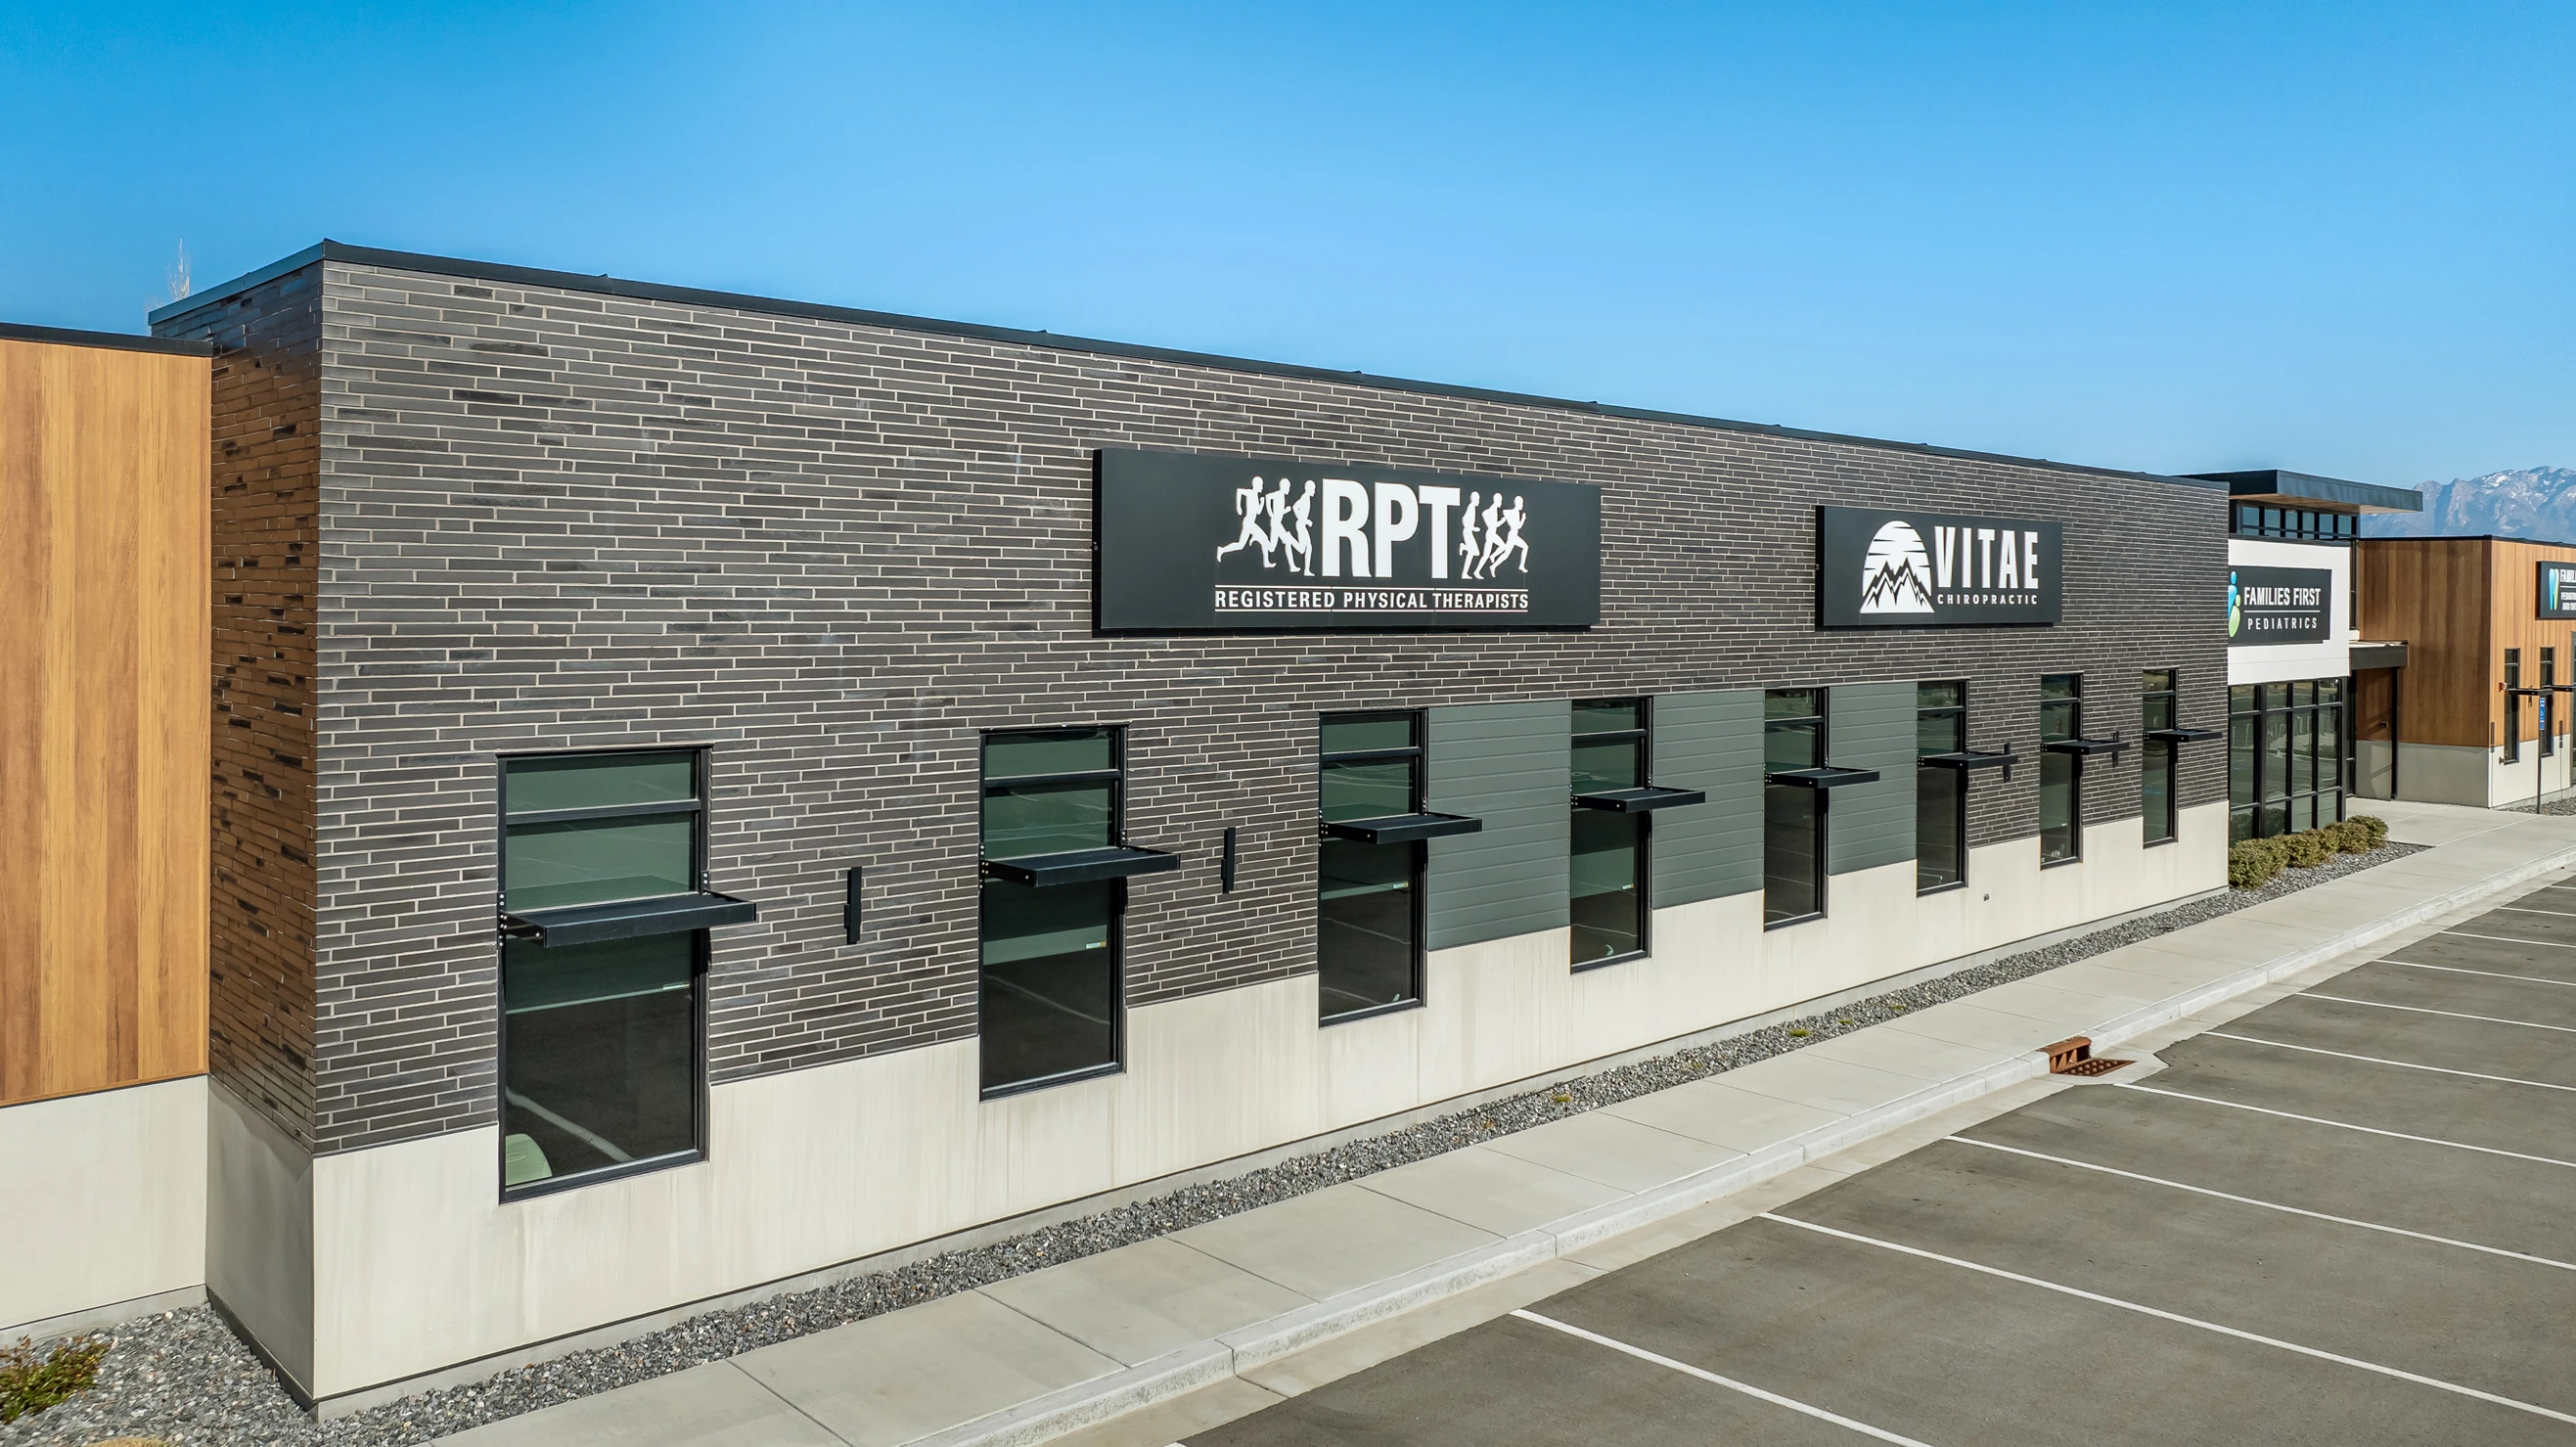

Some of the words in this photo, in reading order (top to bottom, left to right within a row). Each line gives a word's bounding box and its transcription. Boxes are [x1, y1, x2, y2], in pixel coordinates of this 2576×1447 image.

[1322, 477, 1461, 578] RPT
[1934, 525, 2039, 590] VITAE
[1215, 590, 1334, 608] REGISTERED
[1343, 592, 1427, 609] PHYSICAL
[1432, 592, 1528, 609] THERAPISTS
[1937, 594, 2038, 605] CHIROPRACTIC
[2243, 586, 2290, 606] FAMILIES
[2292, 587, 2321, 606] FIRST
[2247, 617, 2317, 630] PEDIATRICS
